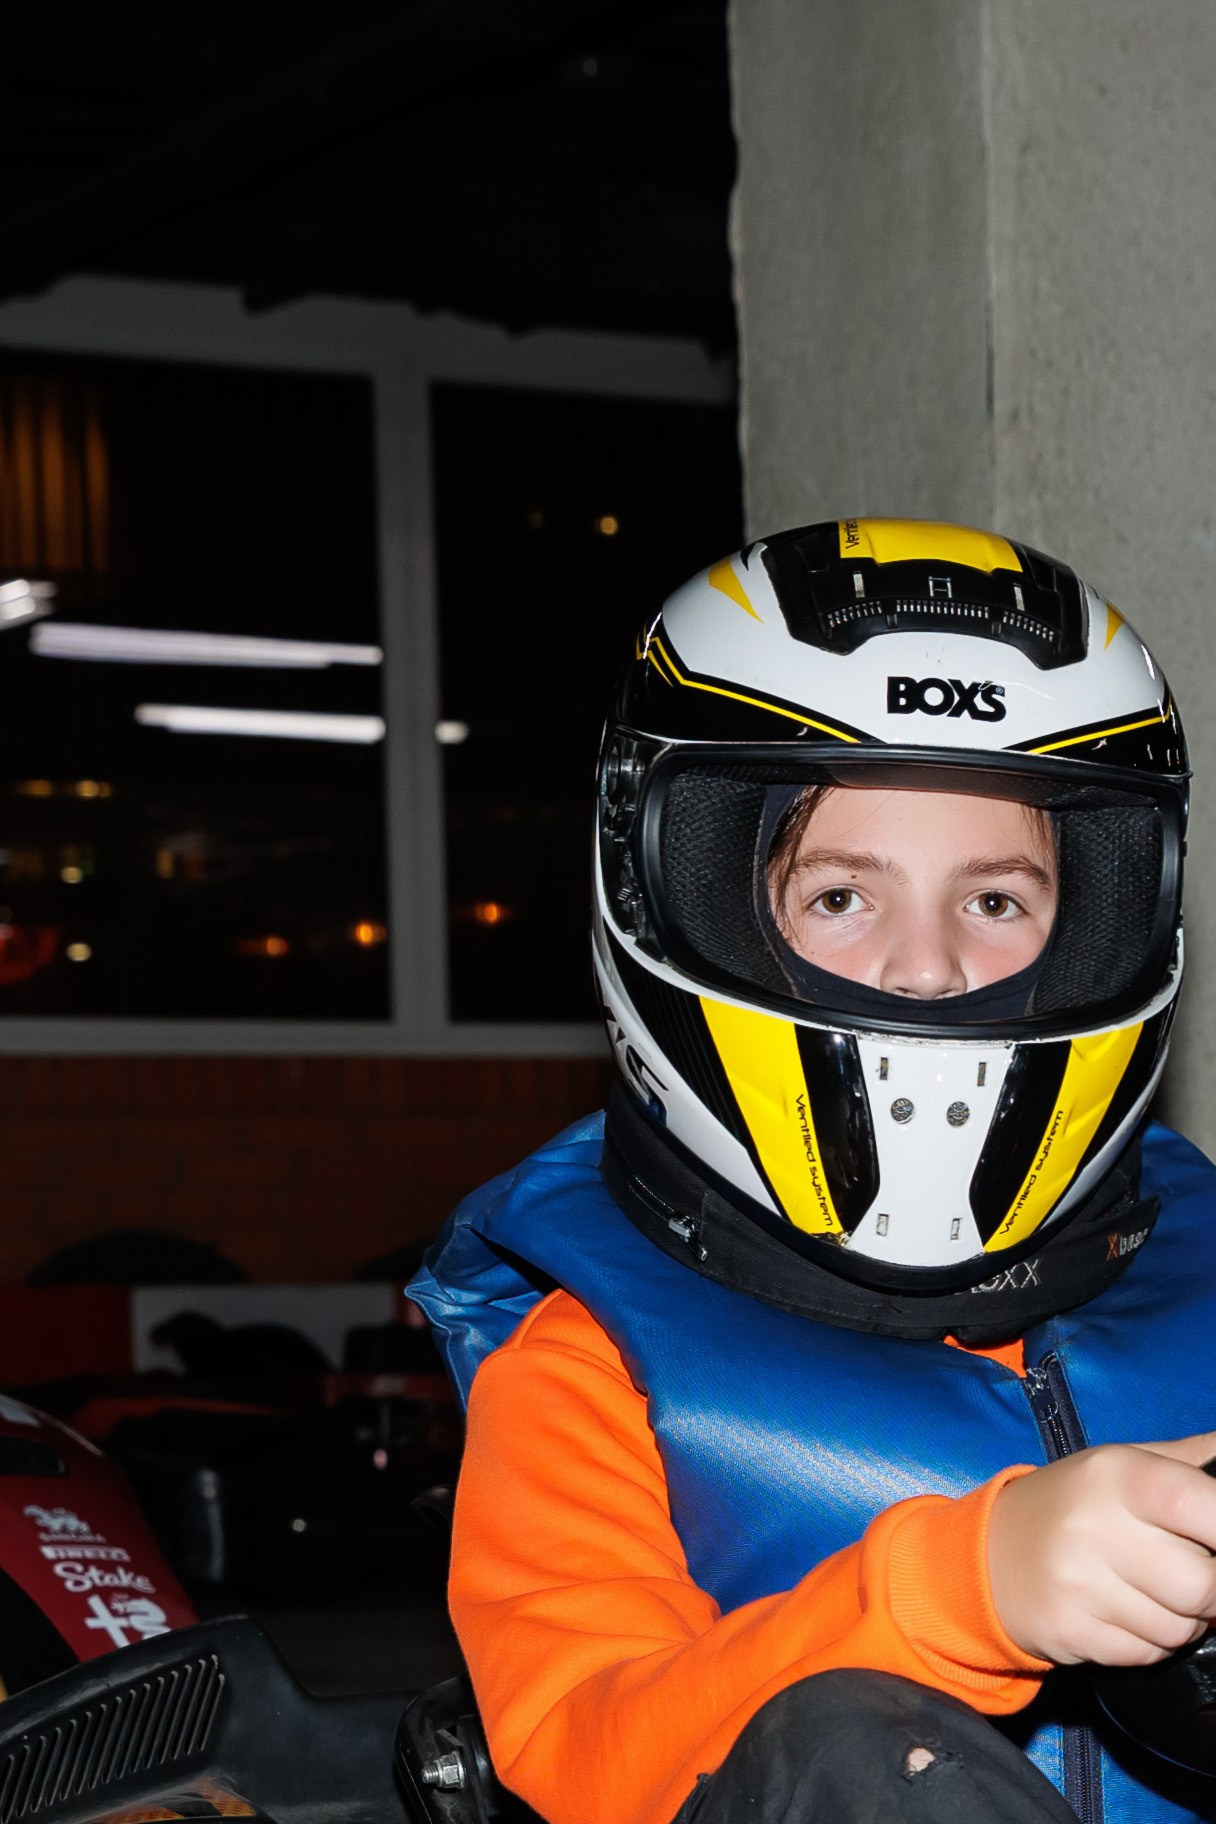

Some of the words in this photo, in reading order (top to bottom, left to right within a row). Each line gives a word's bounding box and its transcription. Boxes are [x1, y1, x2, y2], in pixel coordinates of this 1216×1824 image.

[1035, 1109, 1064, 1172] system
[809, 1166, 833, 1227] system
[53, 1558, 157, 1594] Stake
